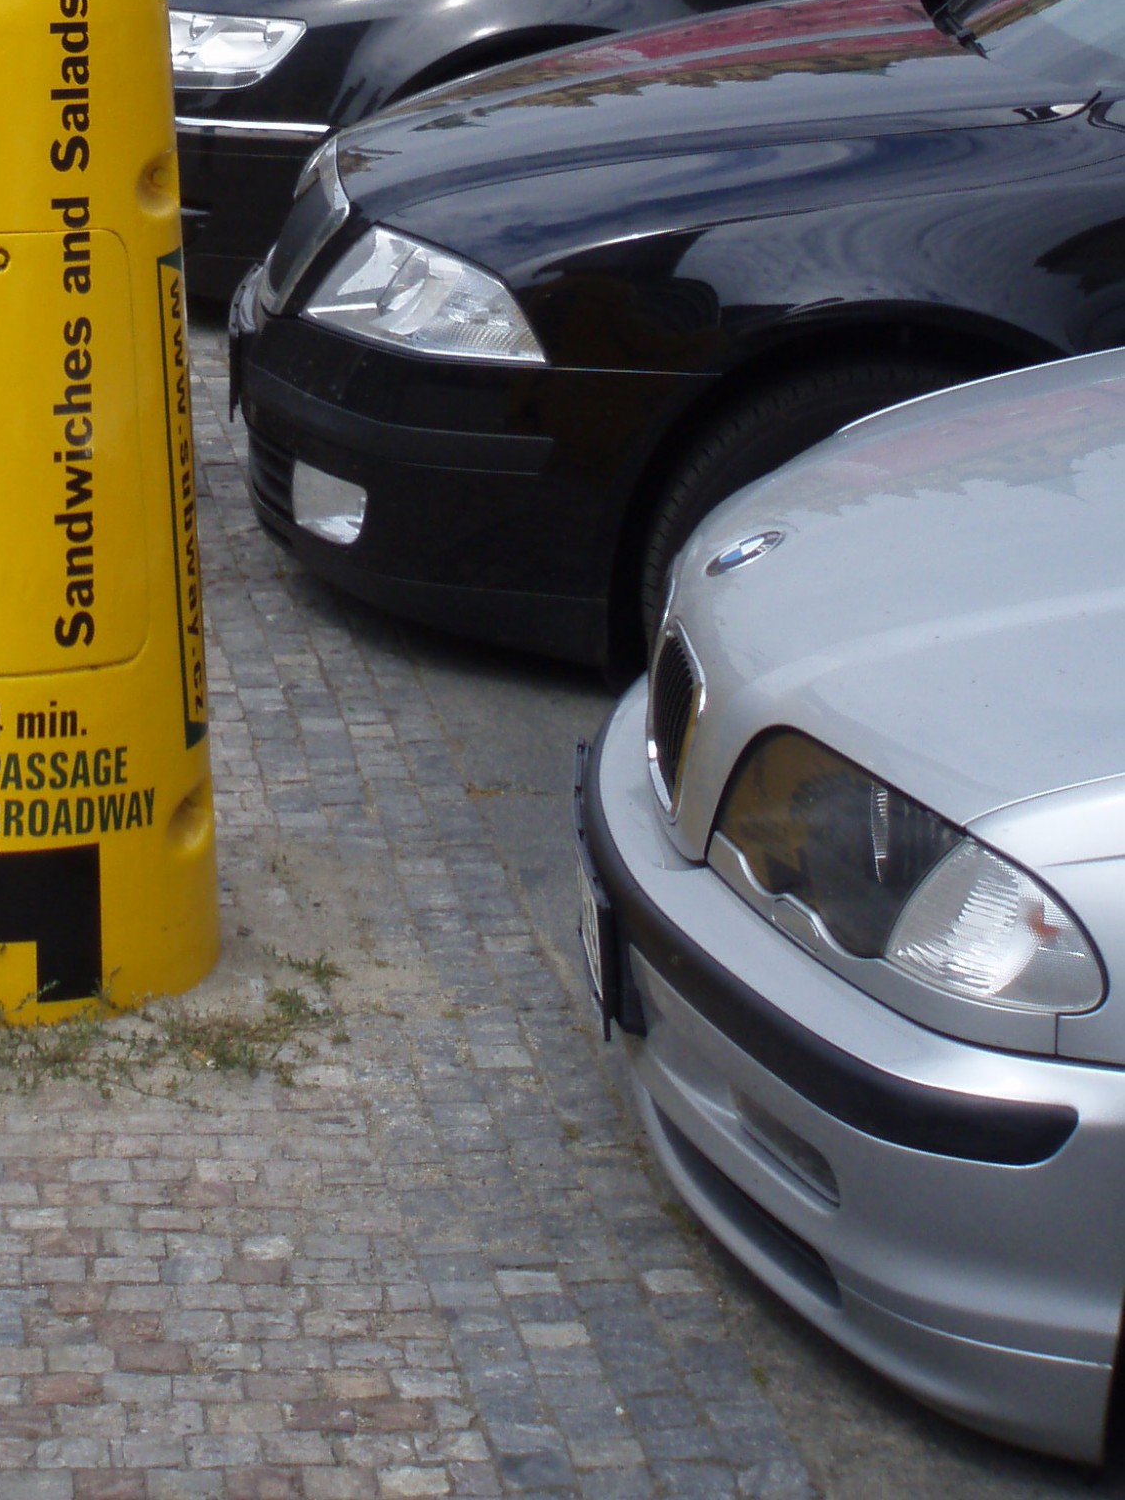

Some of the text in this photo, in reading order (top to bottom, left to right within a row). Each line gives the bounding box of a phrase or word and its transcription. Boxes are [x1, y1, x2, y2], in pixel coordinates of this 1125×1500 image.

[51, 196, 93, 295] and
[52, 314, 96, 648] Sandwiches
[16, 700, 89, 740] min.
